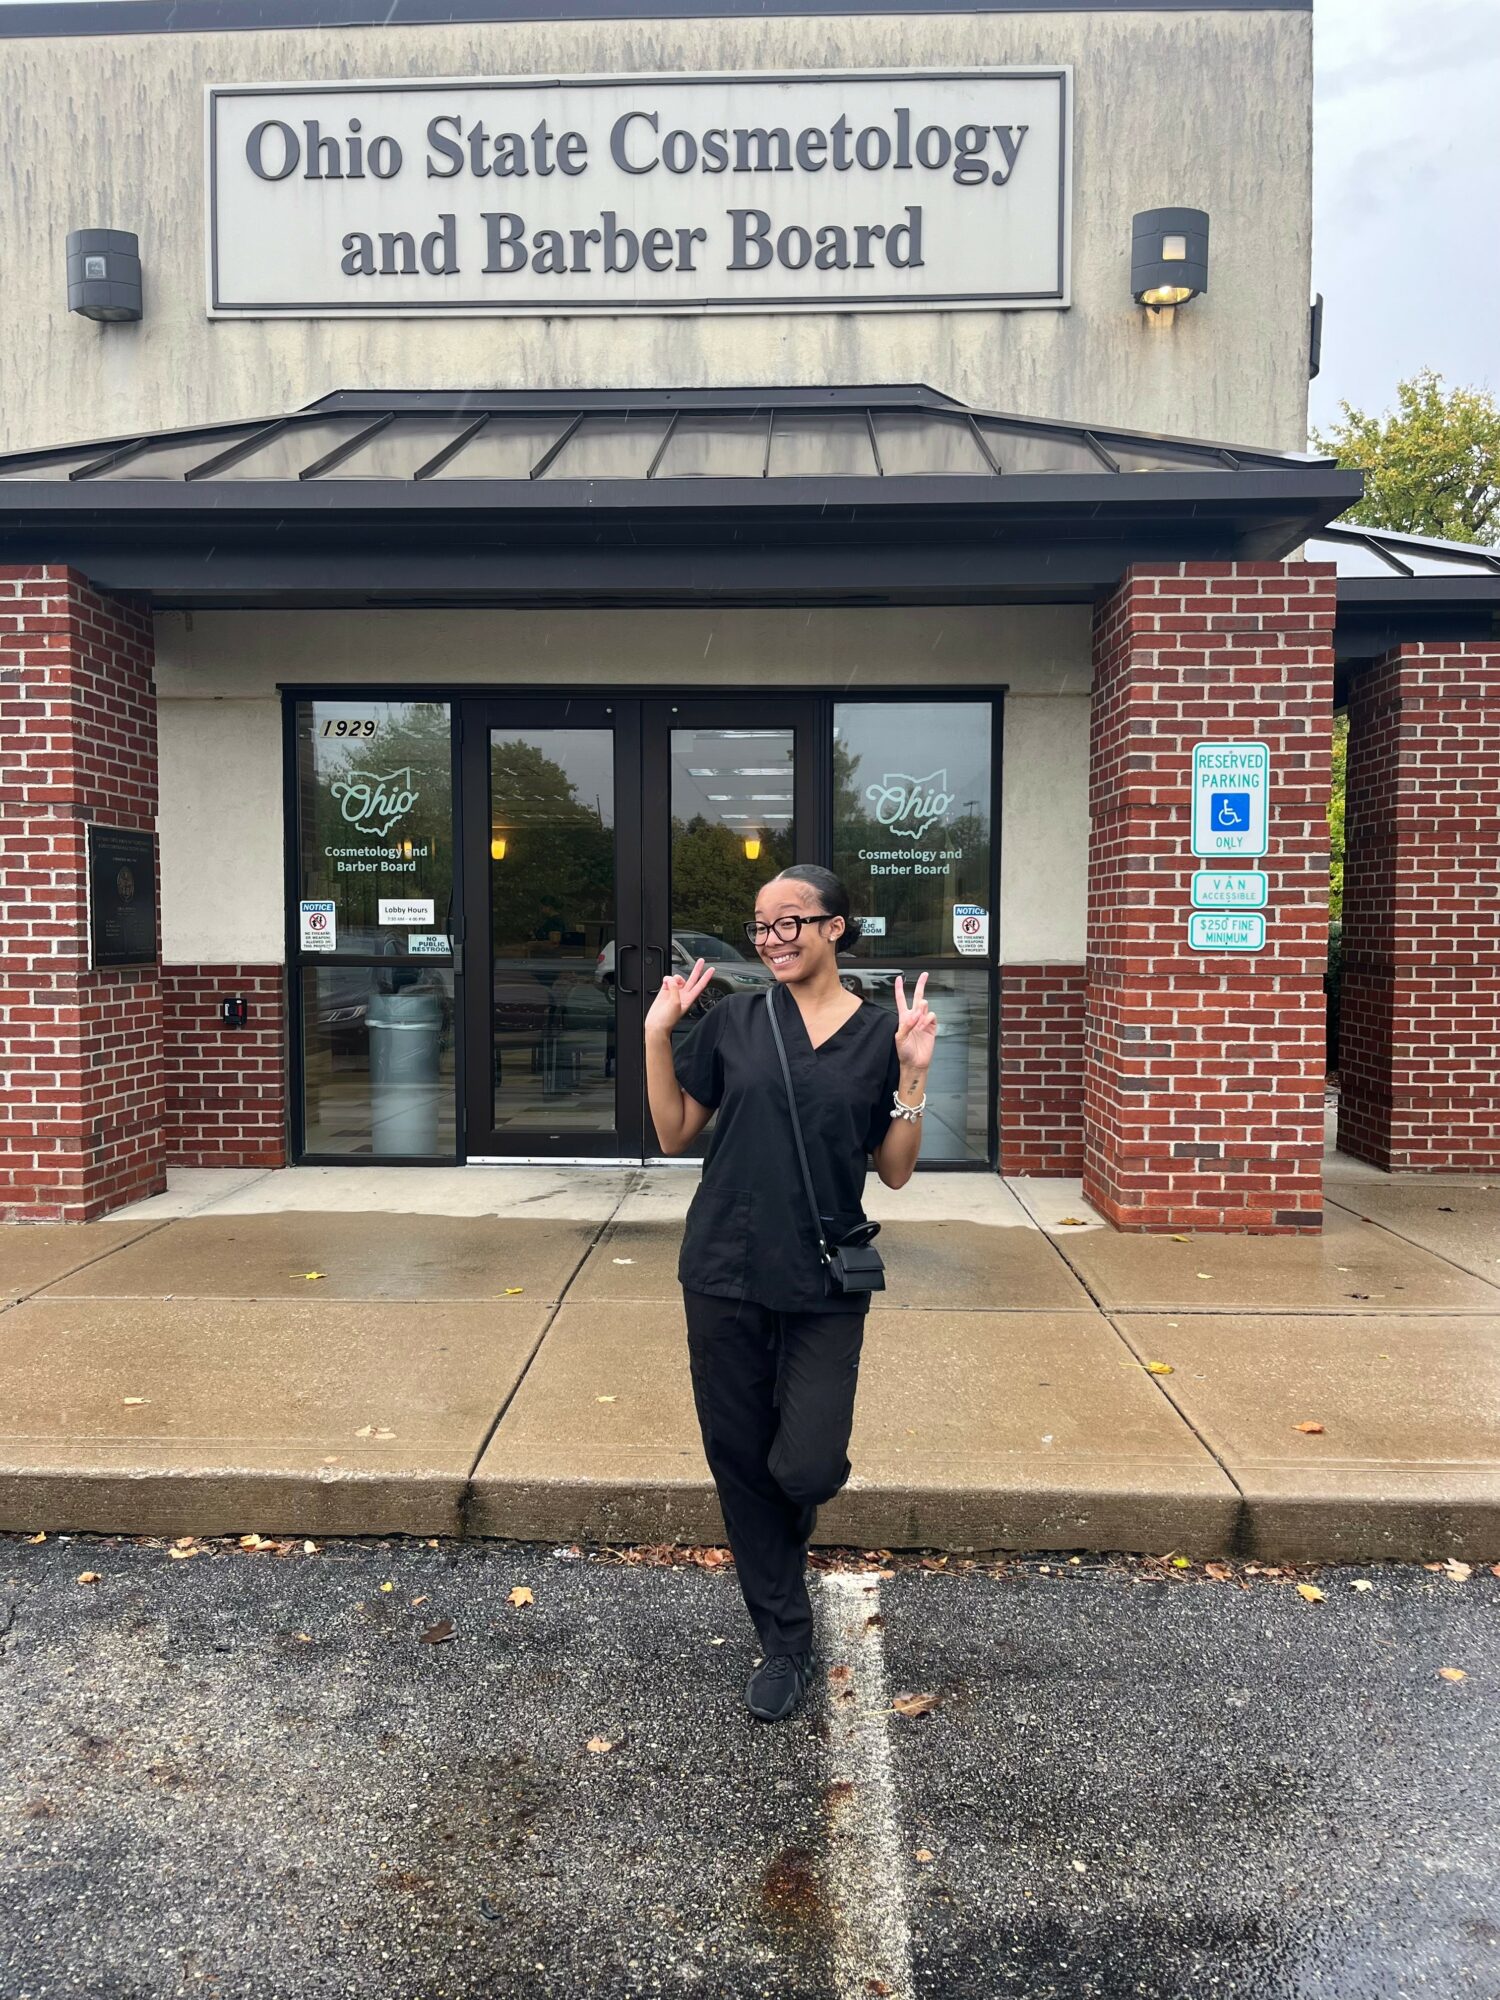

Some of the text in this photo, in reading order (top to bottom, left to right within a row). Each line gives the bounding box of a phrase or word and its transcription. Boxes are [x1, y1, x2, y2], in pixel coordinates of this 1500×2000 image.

[245, 107, 1029, 186] Ohio State Cosmetology
[340, 205, 926, 277] and Barber Board
[322, 720, 376, 737] 1929
[1198, 754, 1263, 769] RESERVED
[1202, 774, 1260, 788] PARKING
[331, 781, 419, 822] Ohio
[866, 784, 955, 824] Ohio
[1216, 837, 1244, 848] ONLY
[324, 845, 428, 859] Cosmetology and
[858, 848, 963, 862] Cosmetology and
[337, 861, 416, 872] Barber Board
[870, 864, 950, 875] Barber Board
[1213, 880, 1246, 890] VAN
[1202, 892, 1256, 900] ACCESSIBLE
[303, 903, 333, 911] NOTICE
[384, 906, 428, 915] Lobby Hours
[956, 907, 985, 915] NOTICE
[1200, 919, 1254, 931] $250 FINE
[1206, 932, 1248, 943] MINIMUM
